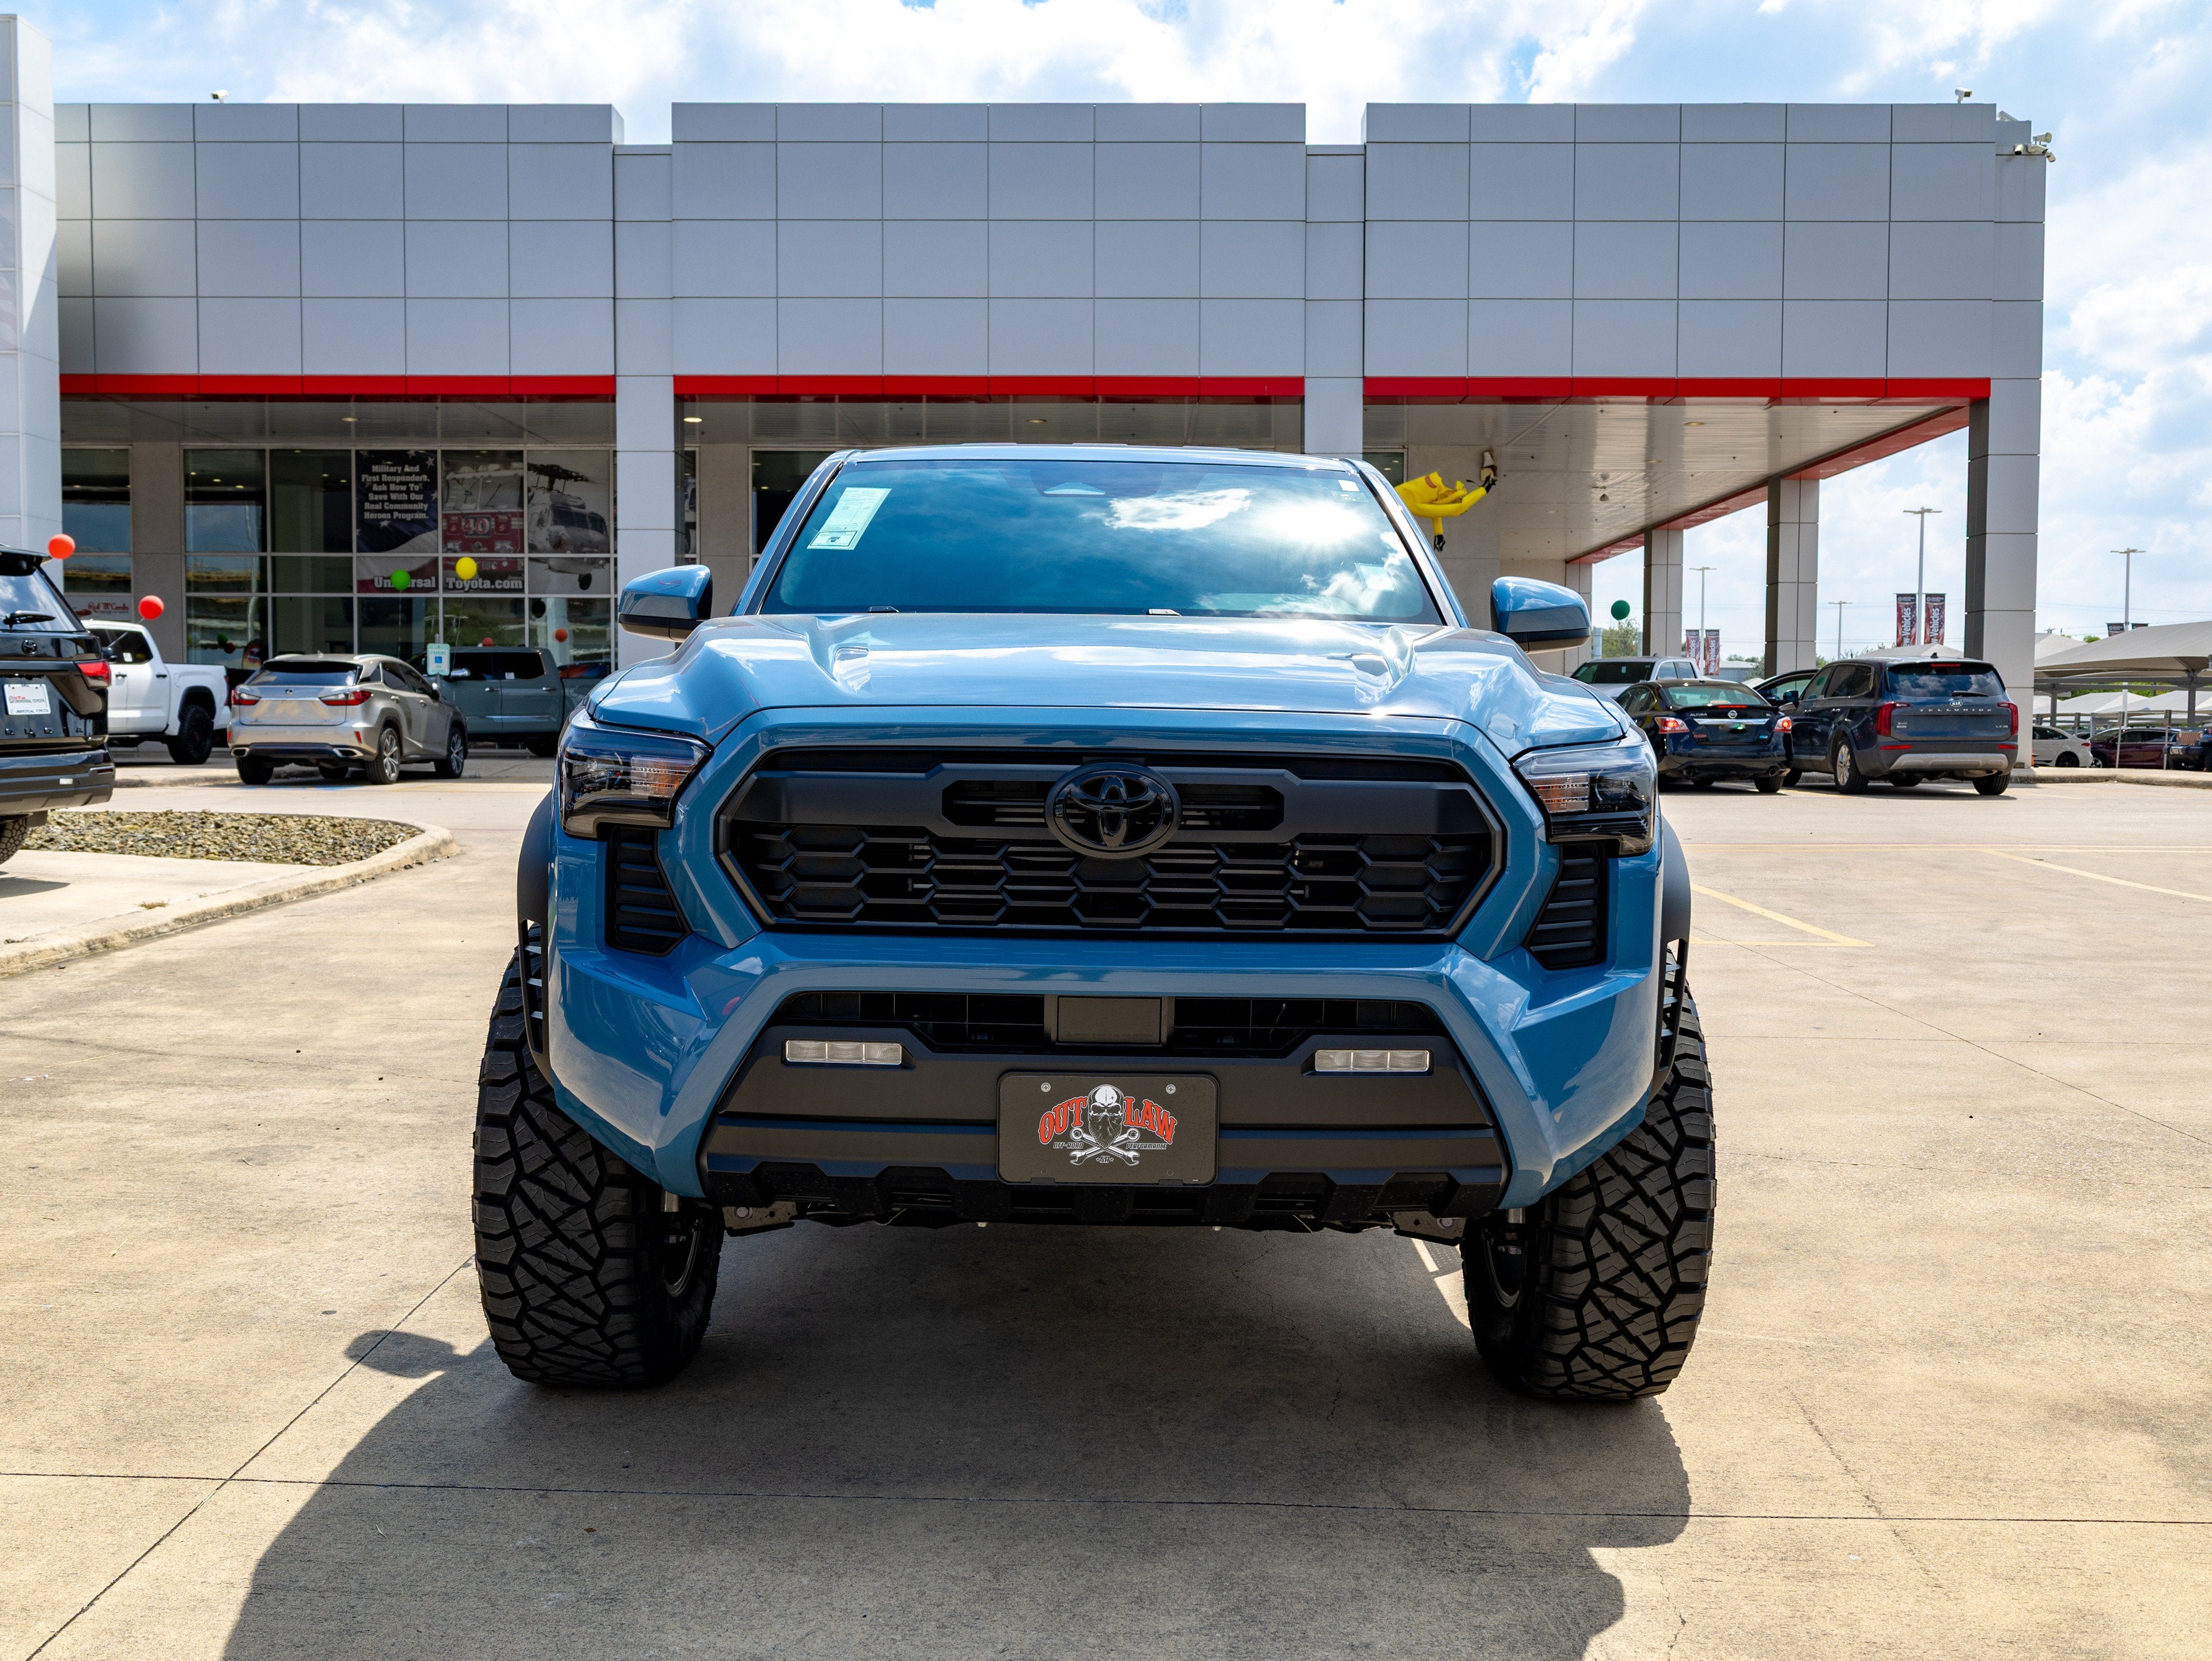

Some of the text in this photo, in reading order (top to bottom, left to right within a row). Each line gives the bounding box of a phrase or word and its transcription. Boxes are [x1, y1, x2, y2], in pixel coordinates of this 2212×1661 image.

[372, 464, 419, 474] Military And
[384, 502, 428, 510] Community
[393, 512, 429, 520] Program.
[374, 576, 523, 592] Unrsal Toyota.com
[1902, 607, 1911, 637] Vehicles
[1930, 608, 1940, 638] Vehicles
